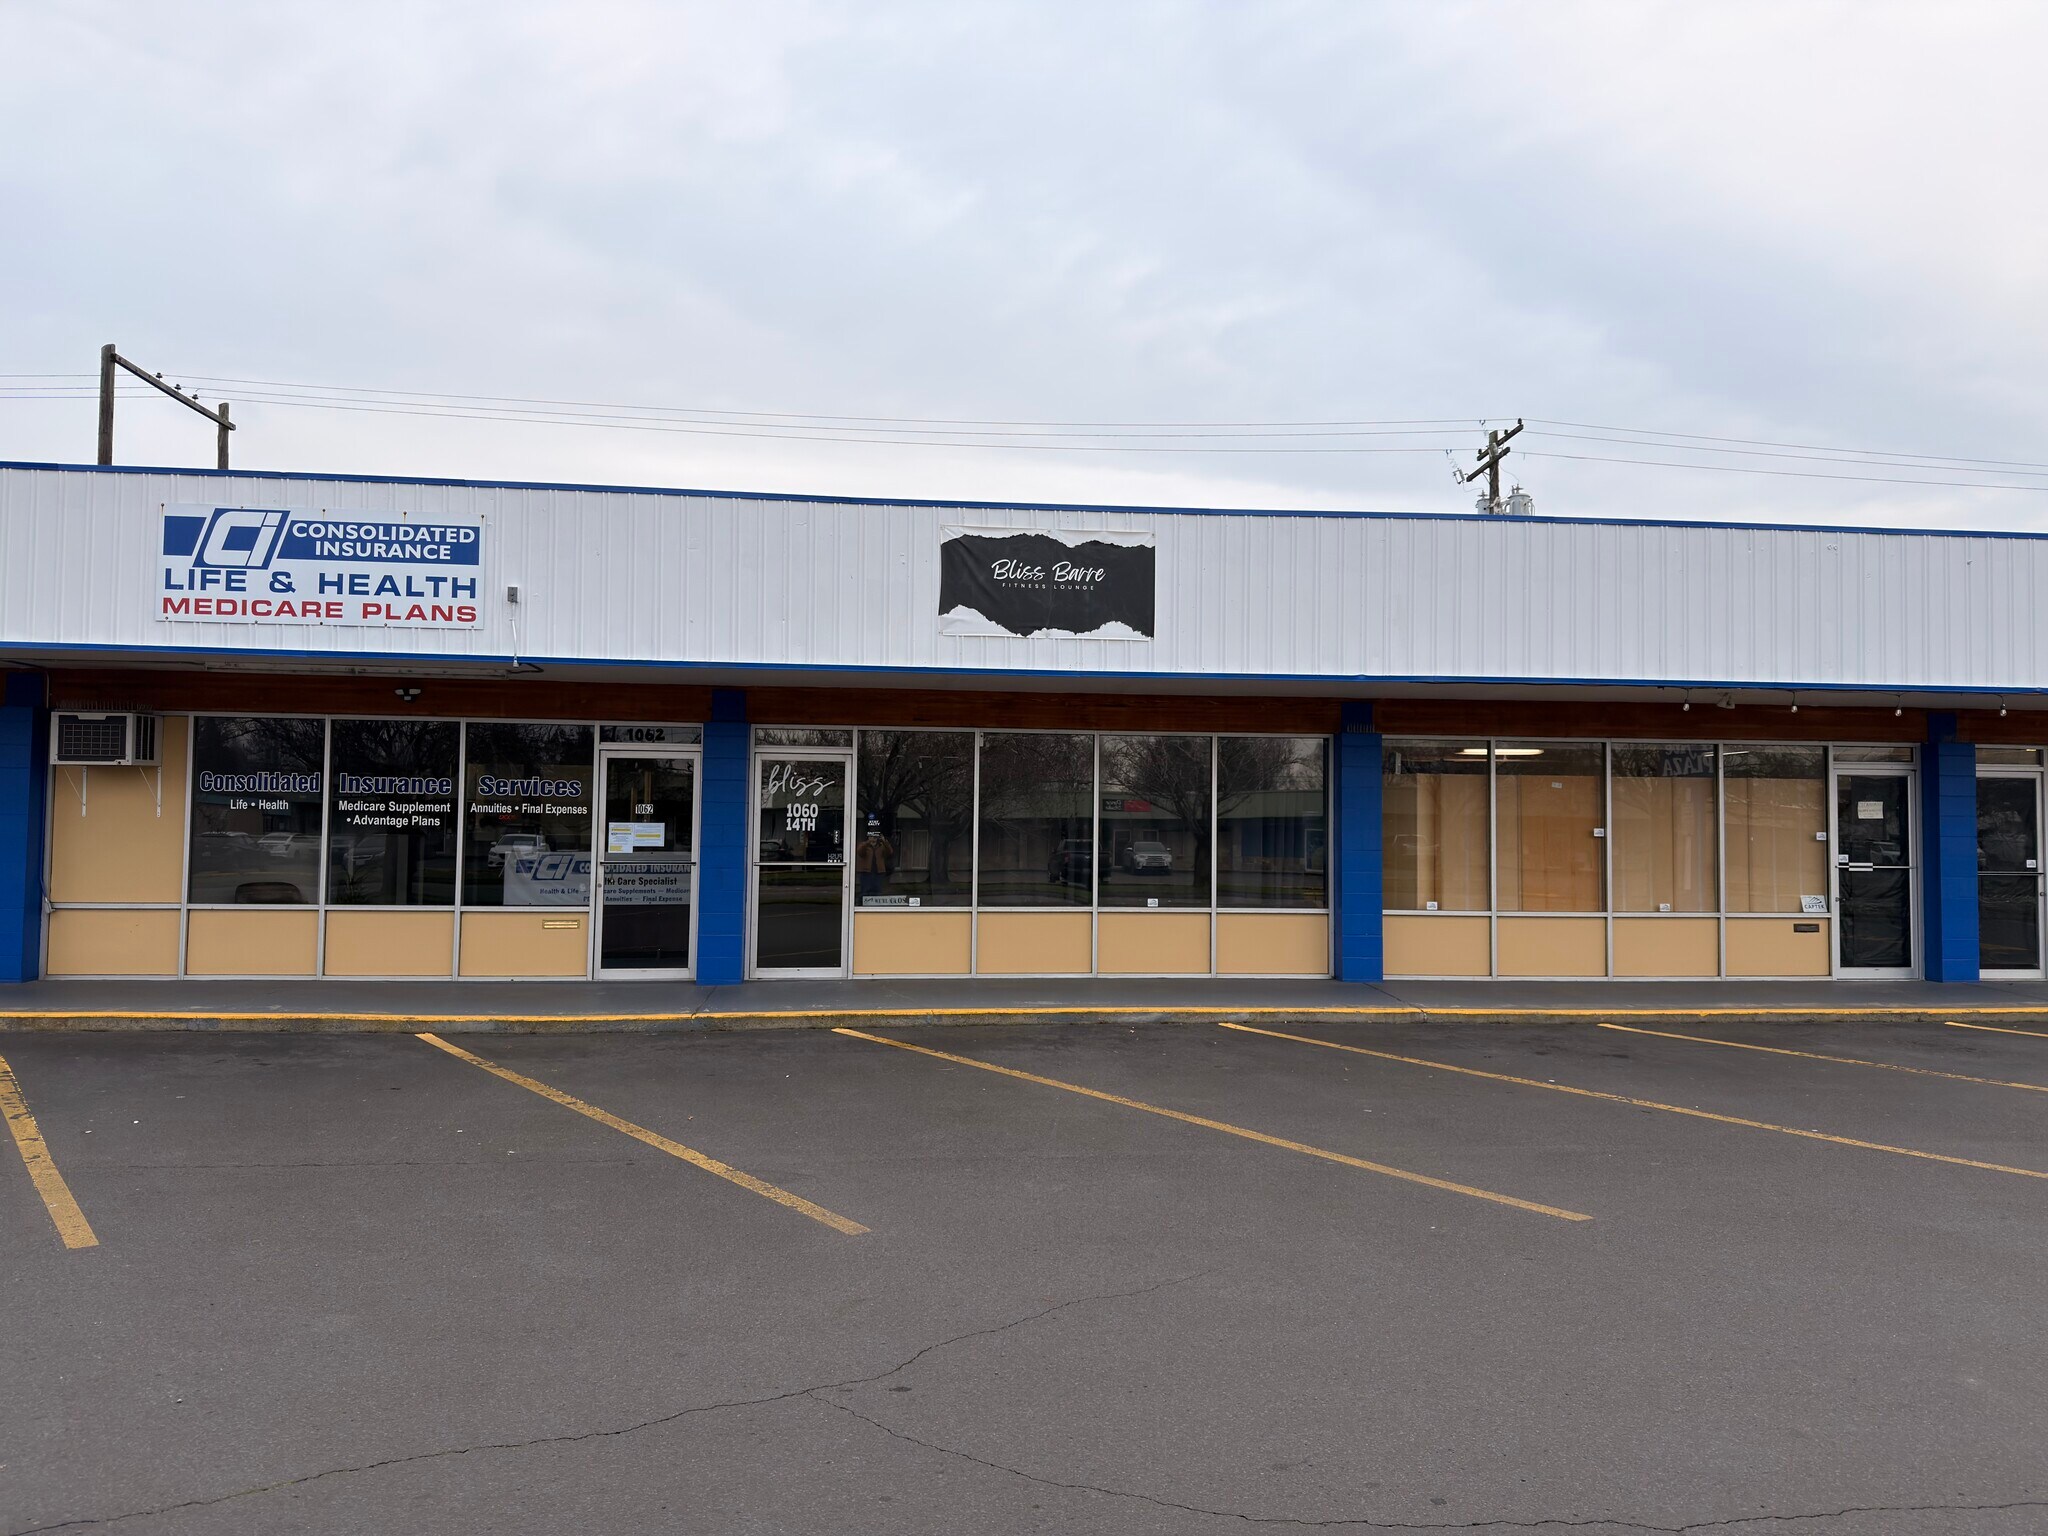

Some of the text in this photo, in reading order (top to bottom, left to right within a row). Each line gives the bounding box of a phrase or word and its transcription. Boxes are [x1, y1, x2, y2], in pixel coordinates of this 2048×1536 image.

[292, 522, 475, 544] CONSOLIDATED
[315, 541, 451, 560] INSURANCE
[991, 559, 1106, 583] Bliss Barre
[164, 568, 477, 599] LIFE & HEALTH
[162, 597, 477, 622] MEDICARE PLANS
[627, 728, 665, 742] 1062
[200, 771, 582, 797] Consolidated Insurance Services
[768, 764, 835, 796] bliss
[230, 799, 289, 810] Life Health
[338, 801, 451, 814] Medicare Supplement
[470, 803, 588, 816] Annuities Final Expenses
[635, 804, 653, 814] 1062
[786, 803, 819, 818] 1060
[353, 815, 440, 827] Advantage Plans
[786, 818, 816, 831] 14TH
[650, 864, 691, 873] INSURAN
[617, 877, 636, 885] Care
[638, 877, 678, 887] Specialist
[618, 887, 656, 895] Supplements
